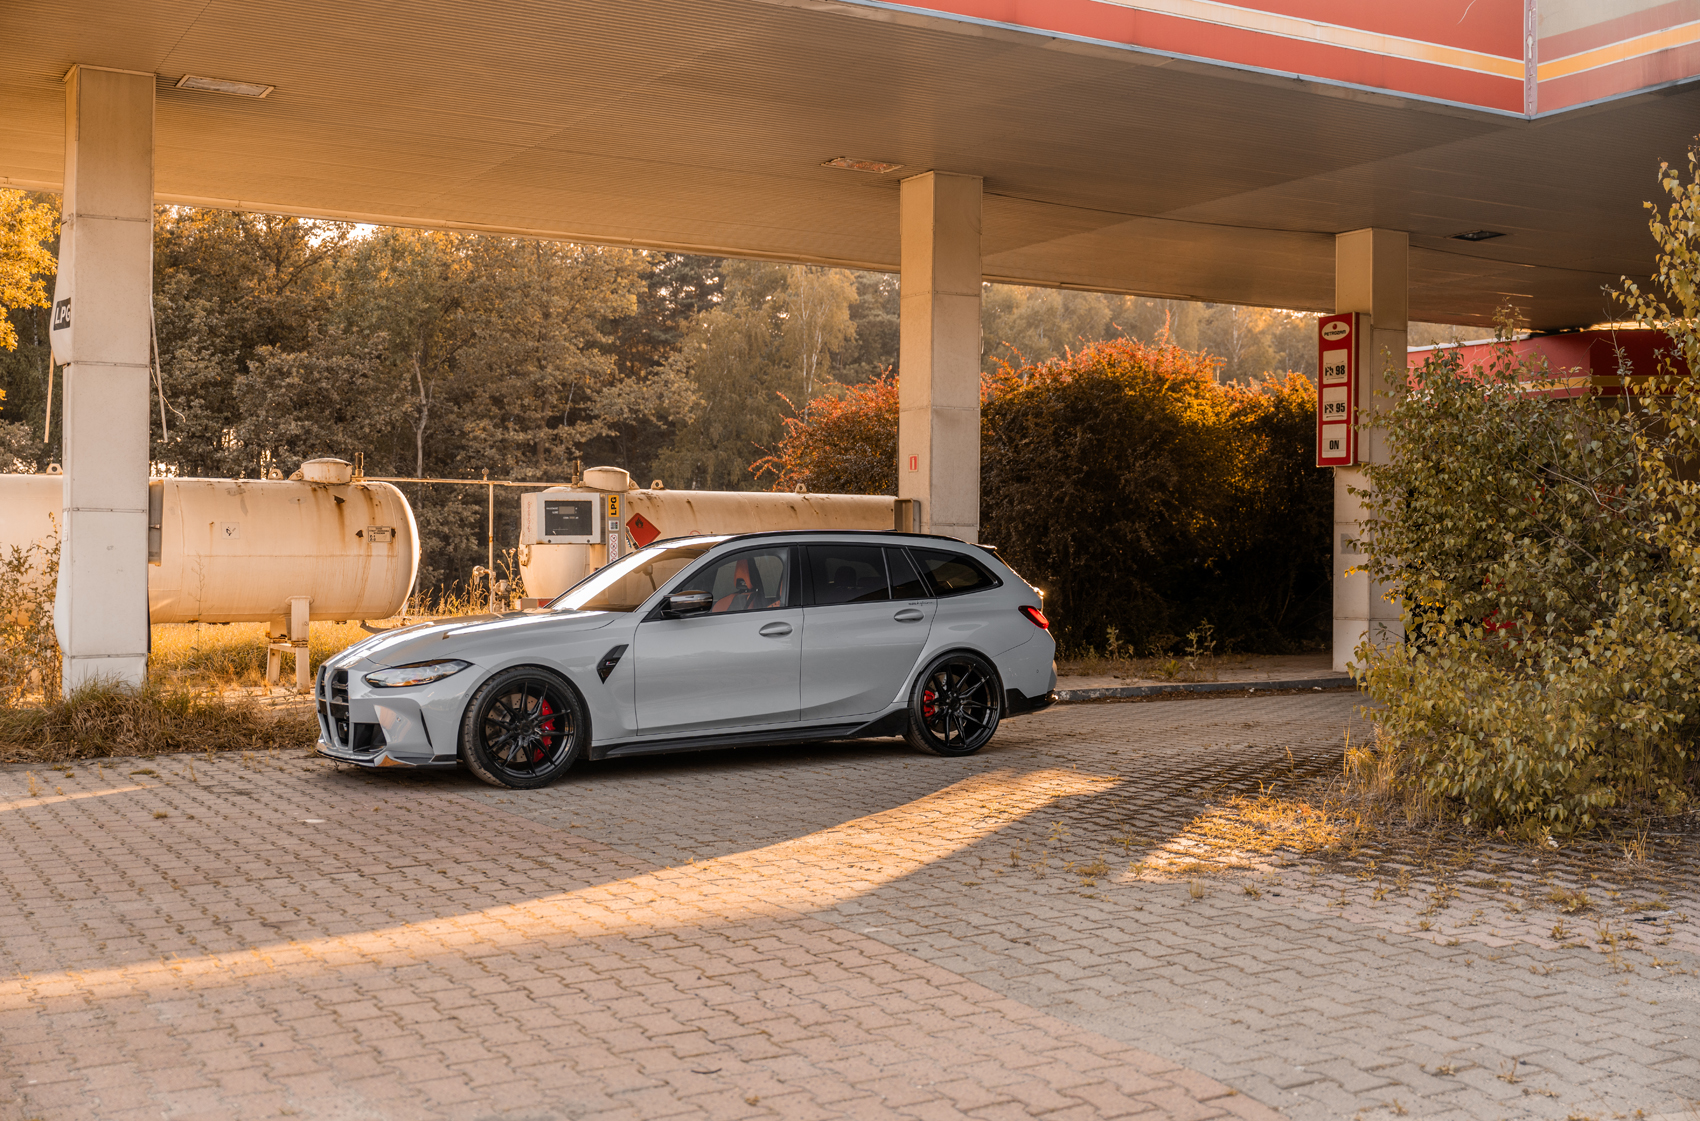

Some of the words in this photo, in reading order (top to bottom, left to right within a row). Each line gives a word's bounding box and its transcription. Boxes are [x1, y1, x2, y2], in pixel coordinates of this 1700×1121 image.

[55, 304, 71, 325] LPG
[1335, 364, 1345, 376] 98
[1336, 402, 1345, 413] 95
[1329, 439, 1340, 450] ON
